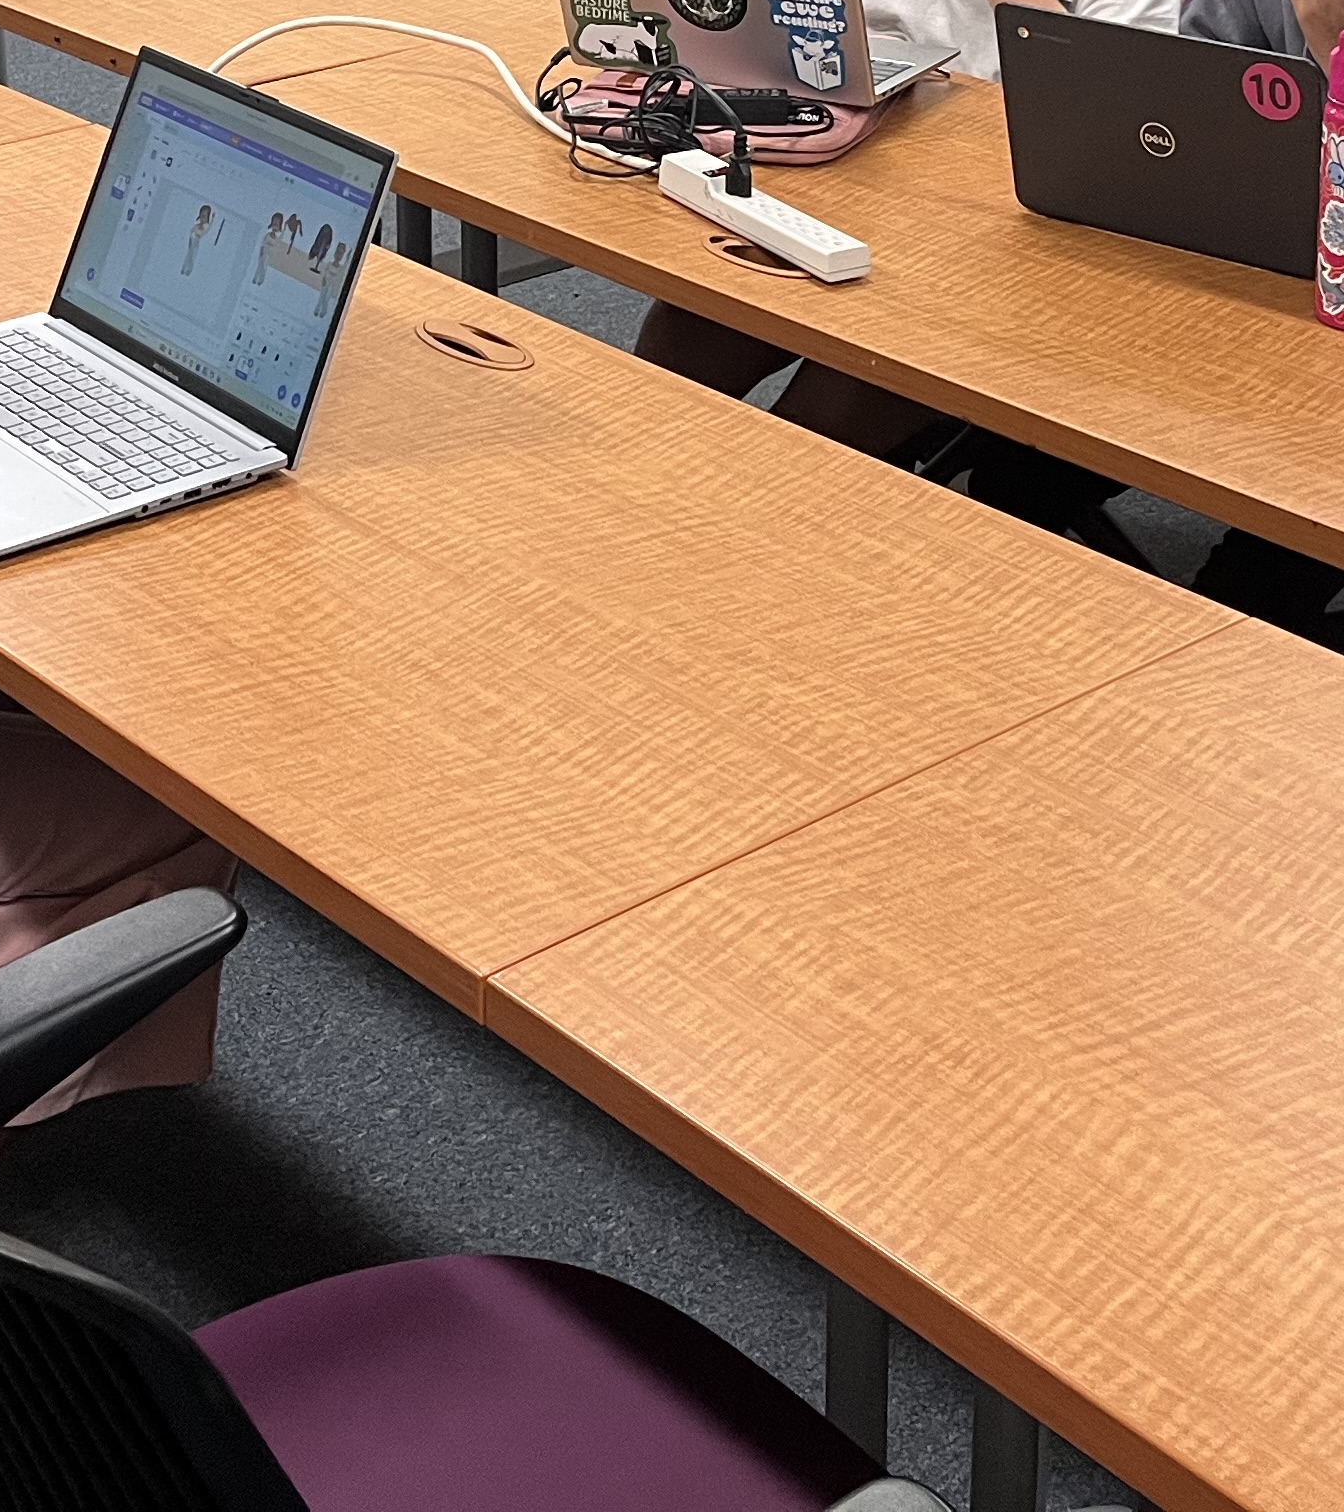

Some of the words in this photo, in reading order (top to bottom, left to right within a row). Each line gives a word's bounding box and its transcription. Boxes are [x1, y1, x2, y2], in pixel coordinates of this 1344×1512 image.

[576, 5, 631, 23] BEDTIME
[780, 0, 835, 19] ewe
[773, 13, 846, 34] reading?
[1248, 72, 1292, 110] 10
[1144, 132, 1172, 148] DELL
